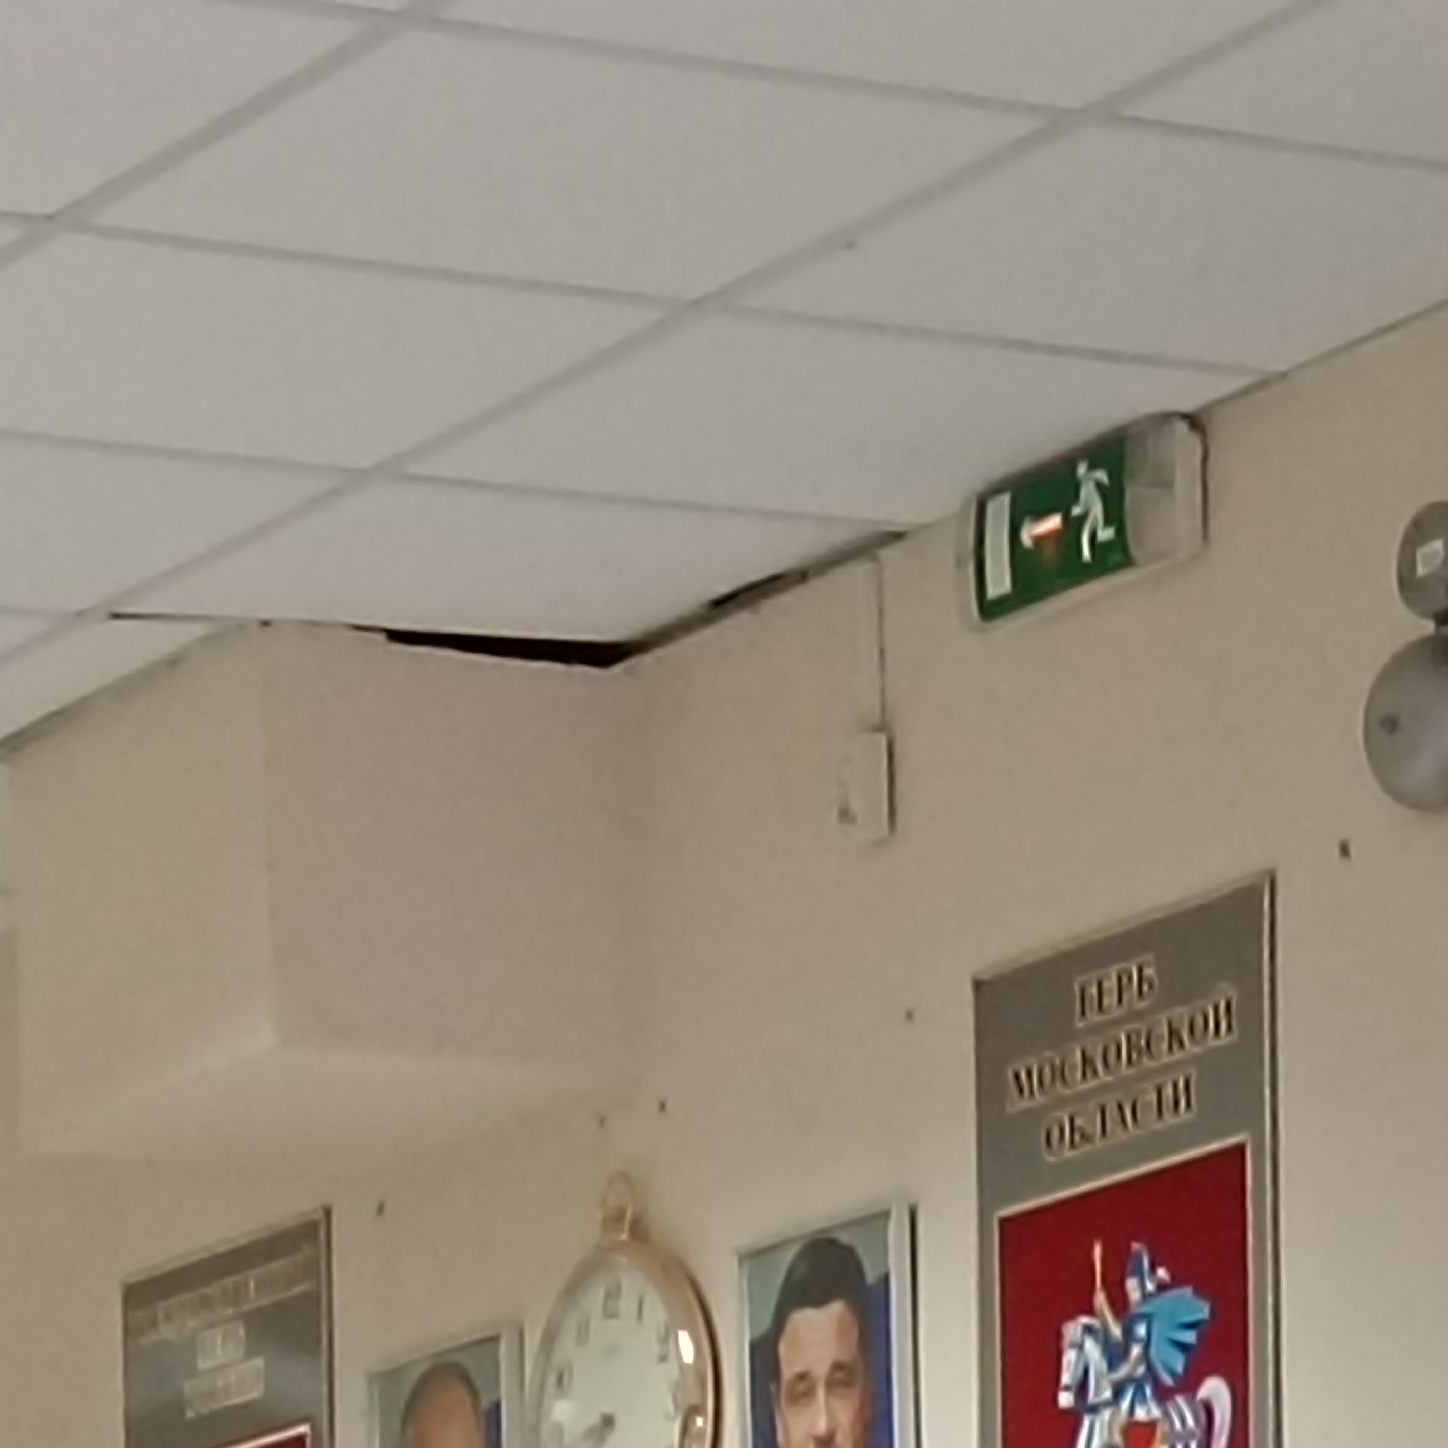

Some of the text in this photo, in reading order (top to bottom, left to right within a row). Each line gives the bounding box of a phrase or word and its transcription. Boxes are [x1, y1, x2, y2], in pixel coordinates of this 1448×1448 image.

[1076, 961, 1156, 1022] ГЕРБ
[1008, 987, 1235, 1105] МОСКОВСКОЙ
[1043, 1074, 1193, 1155] ОБЛАСТИ
